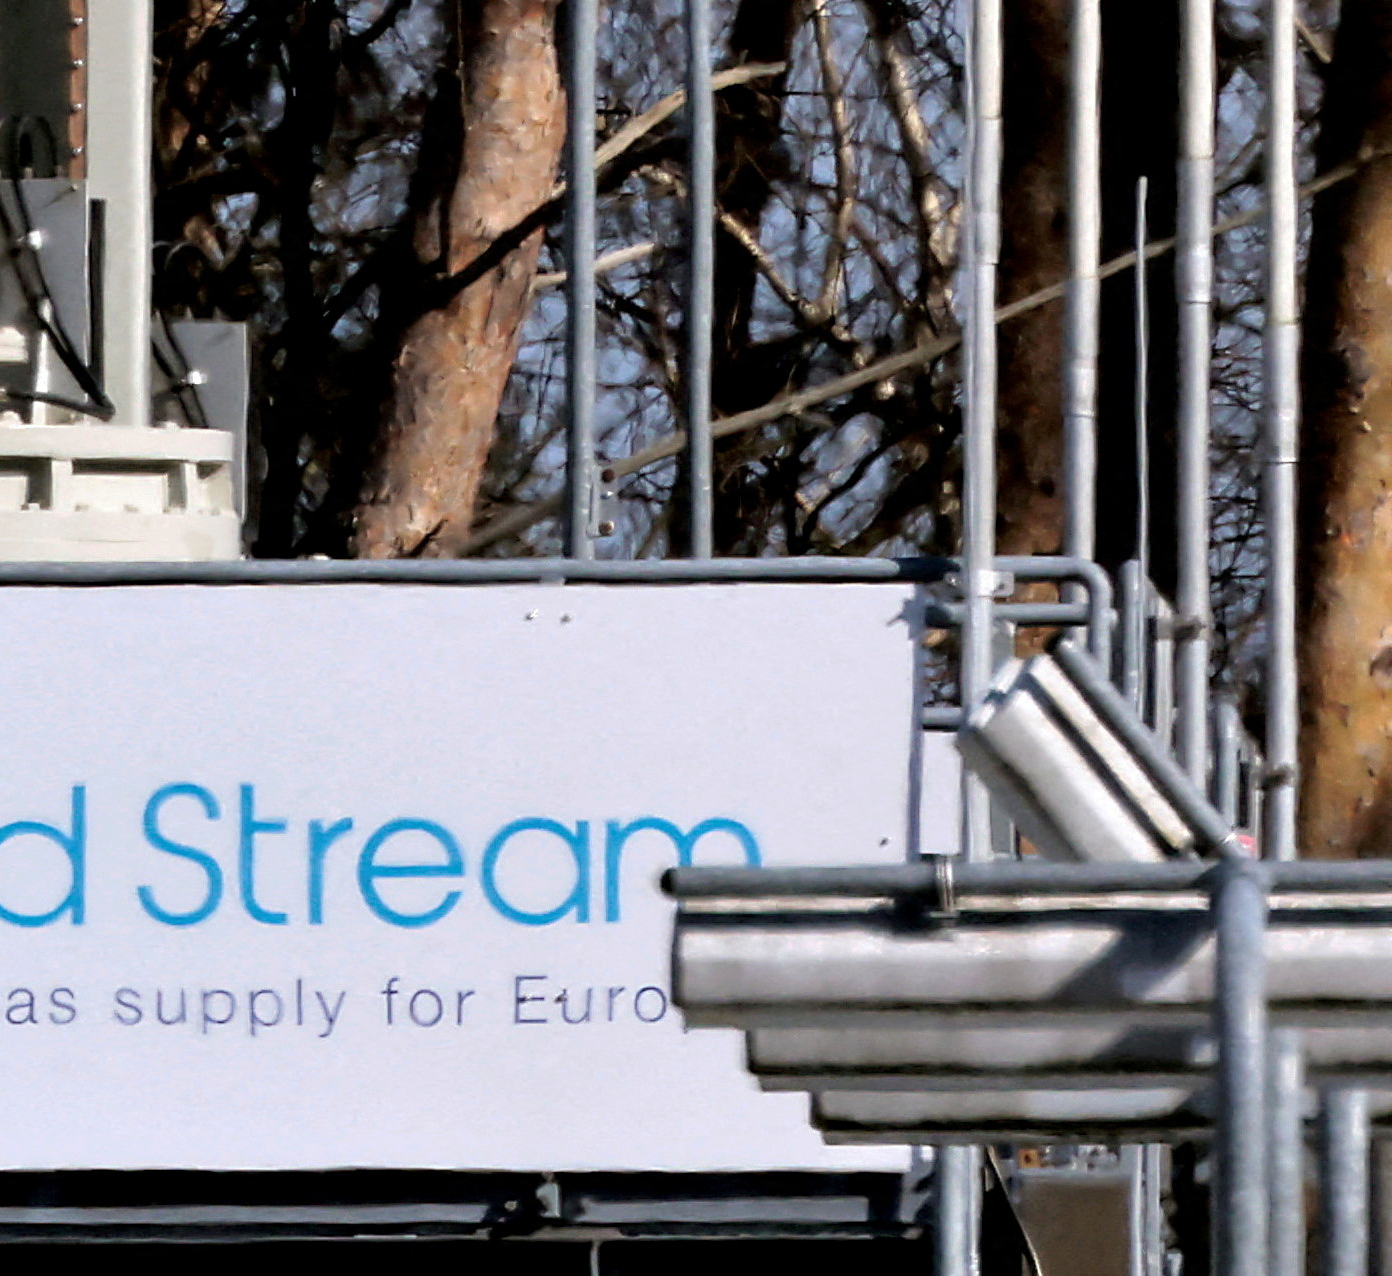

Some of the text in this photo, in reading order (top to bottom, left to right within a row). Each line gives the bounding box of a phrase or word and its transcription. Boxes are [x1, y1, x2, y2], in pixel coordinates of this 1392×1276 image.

[136, 781, 763, 929] Stream
[113, 977, 347, 1039] supply
[380, 976, 476, 1028] for
[513, 975, 669, 1026] Euro
